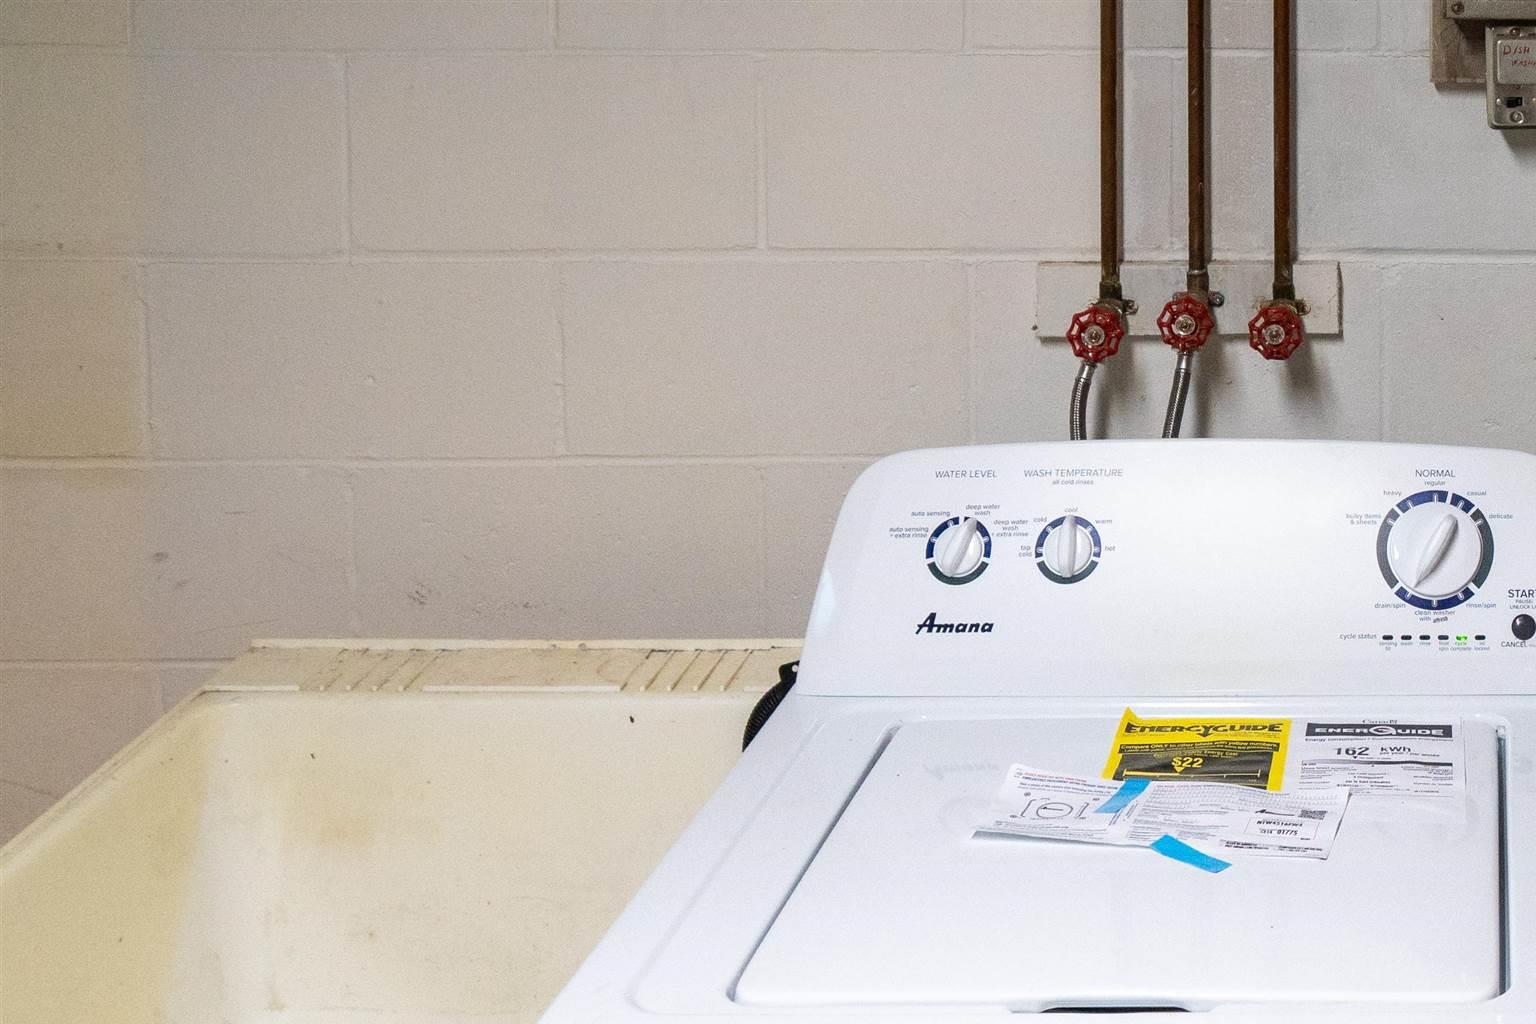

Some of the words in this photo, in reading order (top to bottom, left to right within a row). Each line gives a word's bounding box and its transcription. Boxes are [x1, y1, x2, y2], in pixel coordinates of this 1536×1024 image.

[935, 470, 967, 478] WATER
[969, 470, 998, 478] LEVEL
[1023, 469, 1052, 477] WASH
[1055, 469, 1124, 477] TEMPERATURE
[1415, 469, 1456, 478] NORMAL
[915, 612, 994, 635] Amana
[1125, 722, 1284, 738] ENERGYGUIDE
[1335, 747, 1370, 756] 162
[1171, 756, 1204, 768] $22
